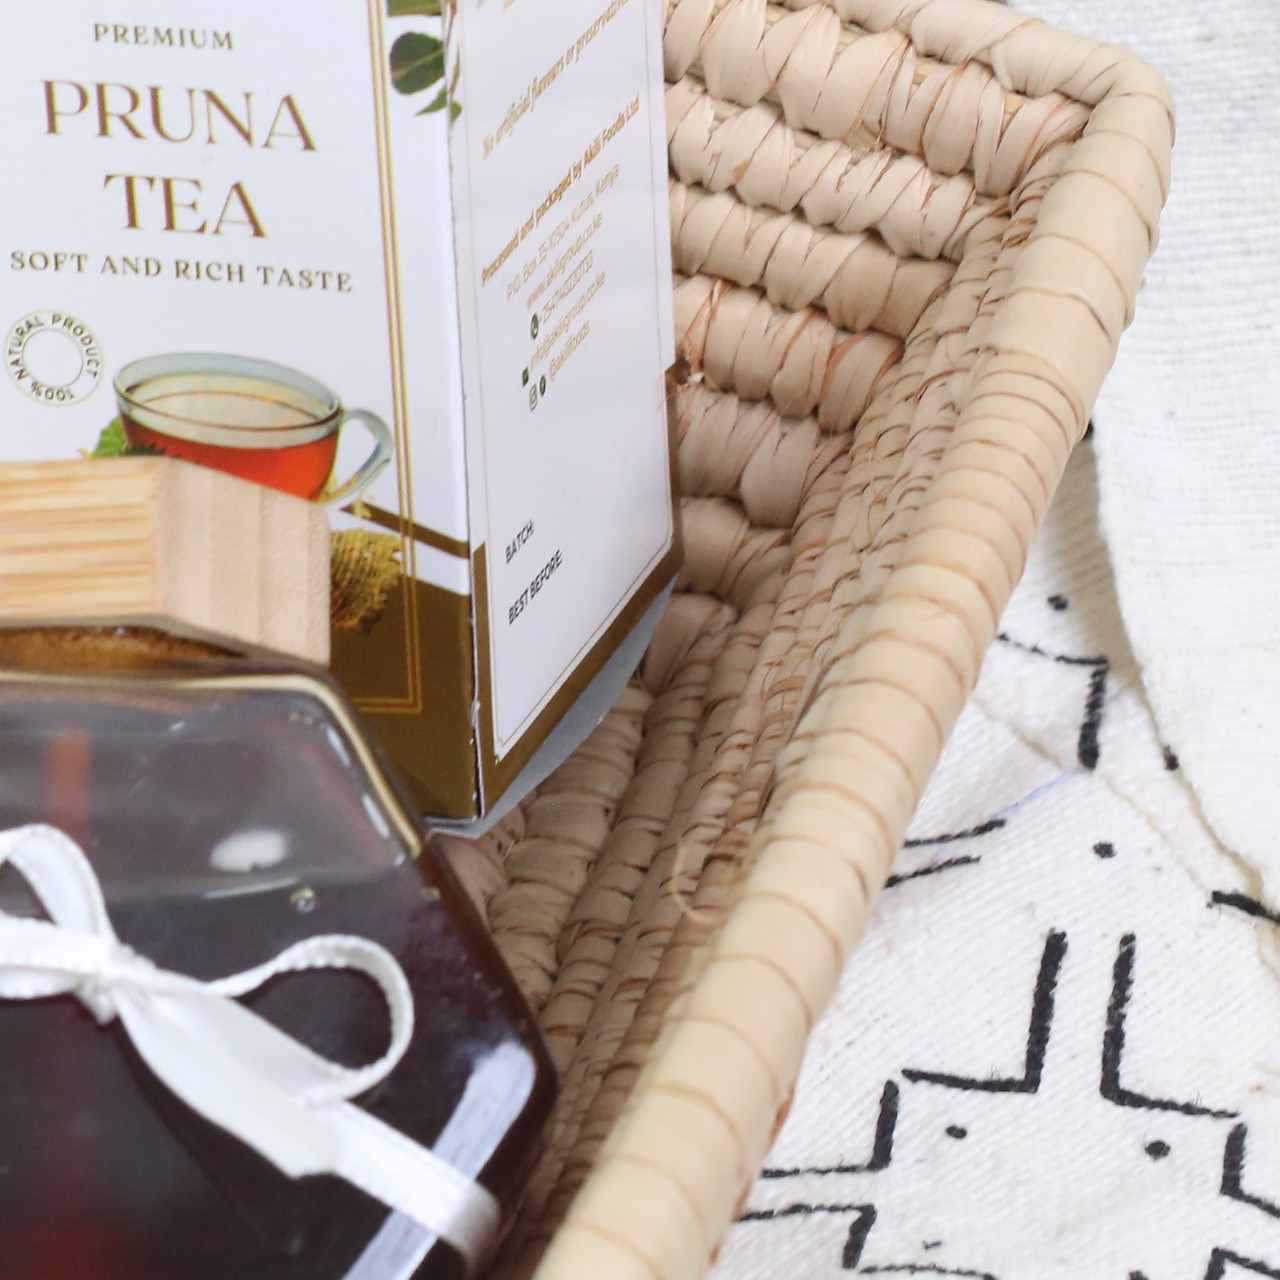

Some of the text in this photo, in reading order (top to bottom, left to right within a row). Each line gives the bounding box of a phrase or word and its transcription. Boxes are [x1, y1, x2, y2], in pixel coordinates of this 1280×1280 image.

[93, 23, 235, 51] PREMIUM
[41, 78, 319, 152] PRUNA
[496, 89, 530, 145] artificial
[530, 76, 565, 112] flavours
[565, 45, 575, 66] or
[103, 173, 269, 239] TEA
[481, 93, 639, 287] Processed and packaged by Akili Foods Ltd
[595, 163, 620, 197] Kenya
[10, 250, 354, 293] SOFT AND RICH TASTE
[8, 313, 99, 402] 100% NATURAL PRODUCT
[508, 587, 529, 626] BEST
